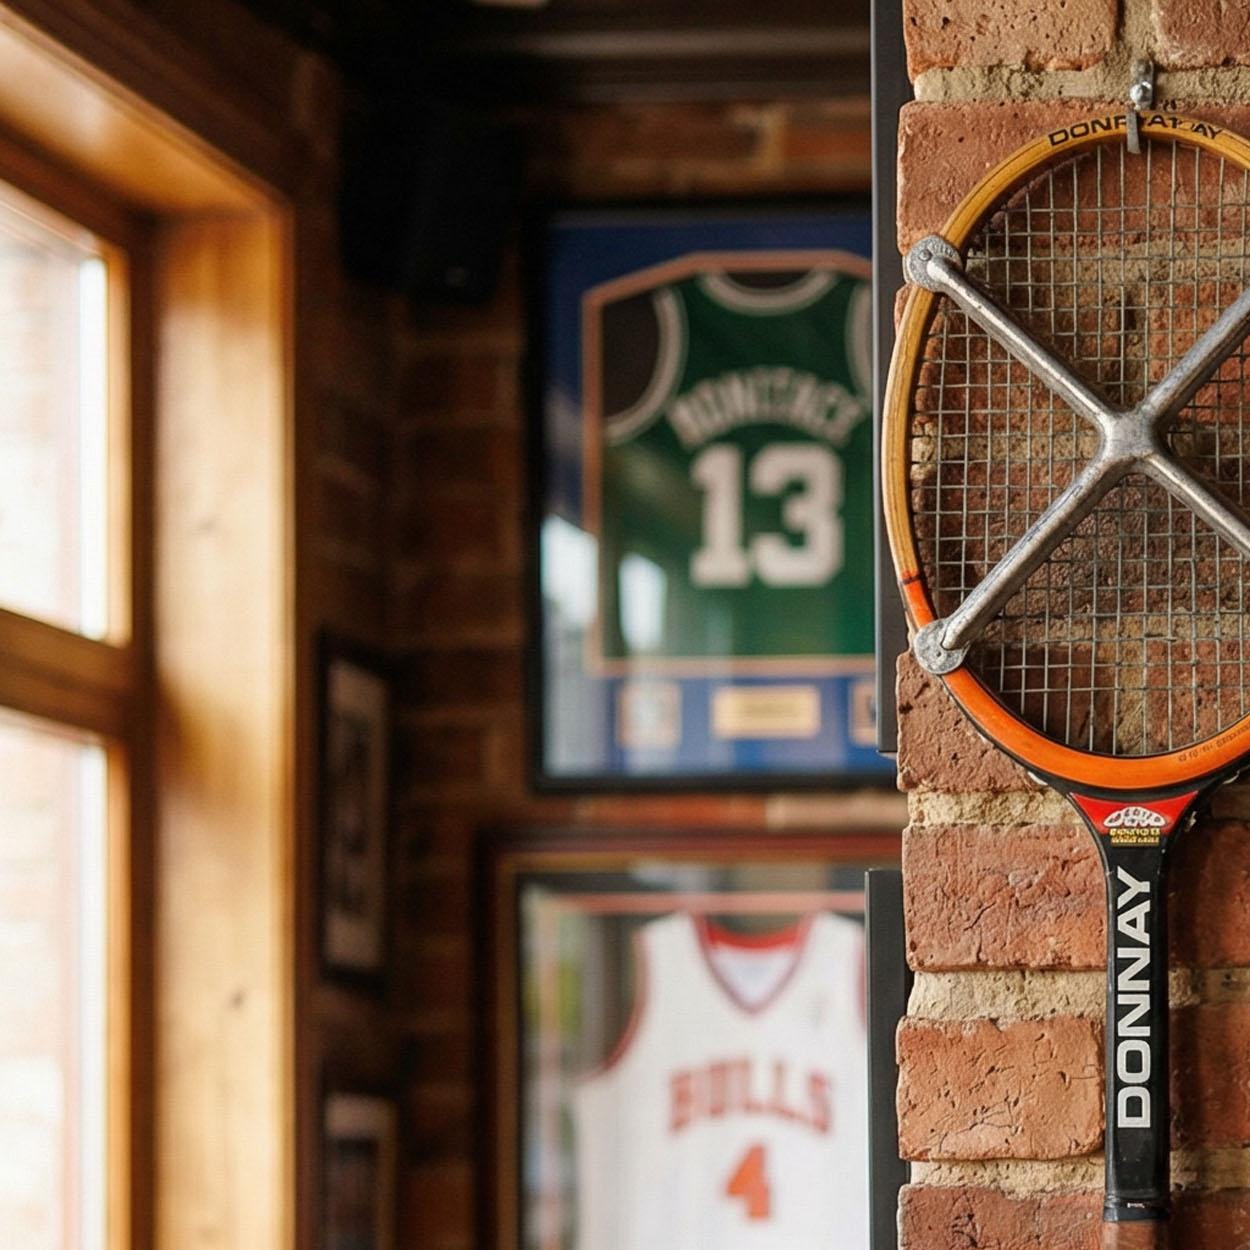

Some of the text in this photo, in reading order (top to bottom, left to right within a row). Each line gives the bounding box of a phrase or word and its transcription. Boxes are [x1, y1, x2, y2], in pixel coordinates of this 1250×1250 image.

[691, 443, 844, 587] 13
[1117, 866, 1151, 1128] DONNAY
[725, 1142, 771, 1222] 4
